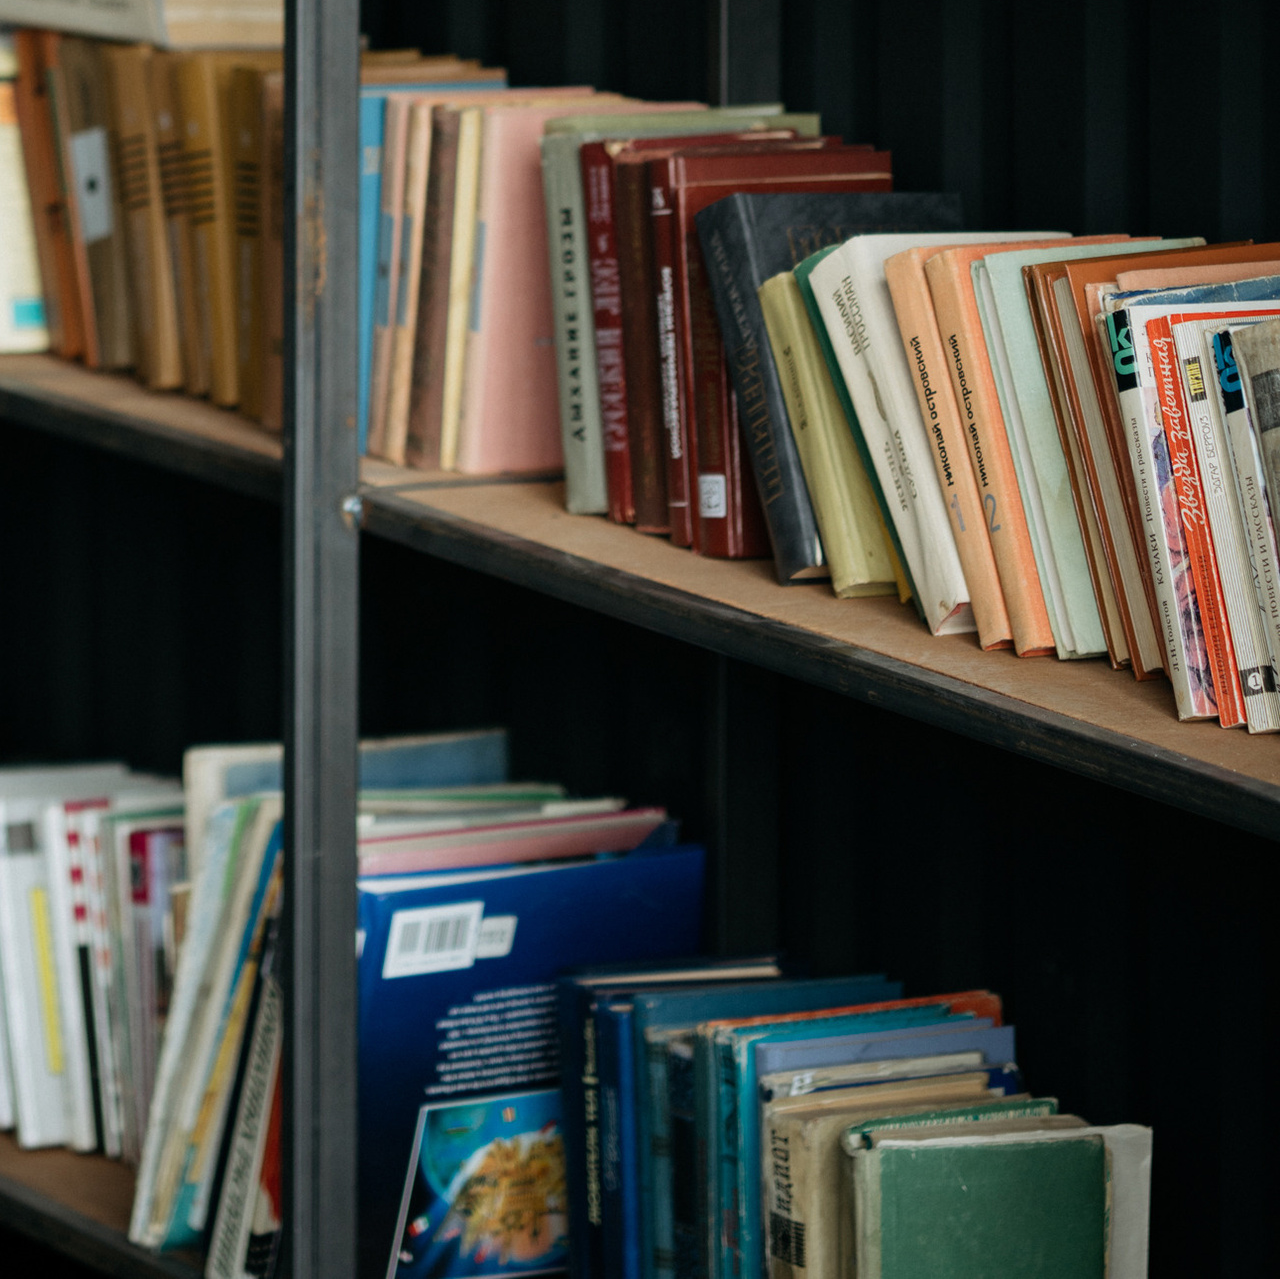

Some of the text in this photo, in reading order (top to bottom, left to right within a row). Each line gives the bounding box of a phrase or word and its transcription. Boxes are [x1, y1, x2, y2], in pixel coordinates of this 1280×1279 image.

[558, 206, 586, 442] ДЫХАНИЕ ГРОЗЫ
[829, 287, 863, 356] ВАСИЛИЙ
[839, 274, 872, 351] ГРОССМАН
[1185, 360, 1205, 396] ТАРЗАН
[892, 428, 919, 500] СУДЬБА
[1129, 416, 1145, 466] рассказы
[1151, 335, 1207, 532] Звезда заветная
[1198, 413, 1223, 494] ЭДГАР БЕРРОУЗ
[980, 491, 1003, 533] 2
[1138, 477, 1154, 522] Повести
[1148, 532, 1164, 584] КАЗАКИ
[1244, 474, 1280, 618] ПОВЕСТИ И РАССКАЗЫ
[1159, 599, 1180, 672] Л.Н.Толстой
